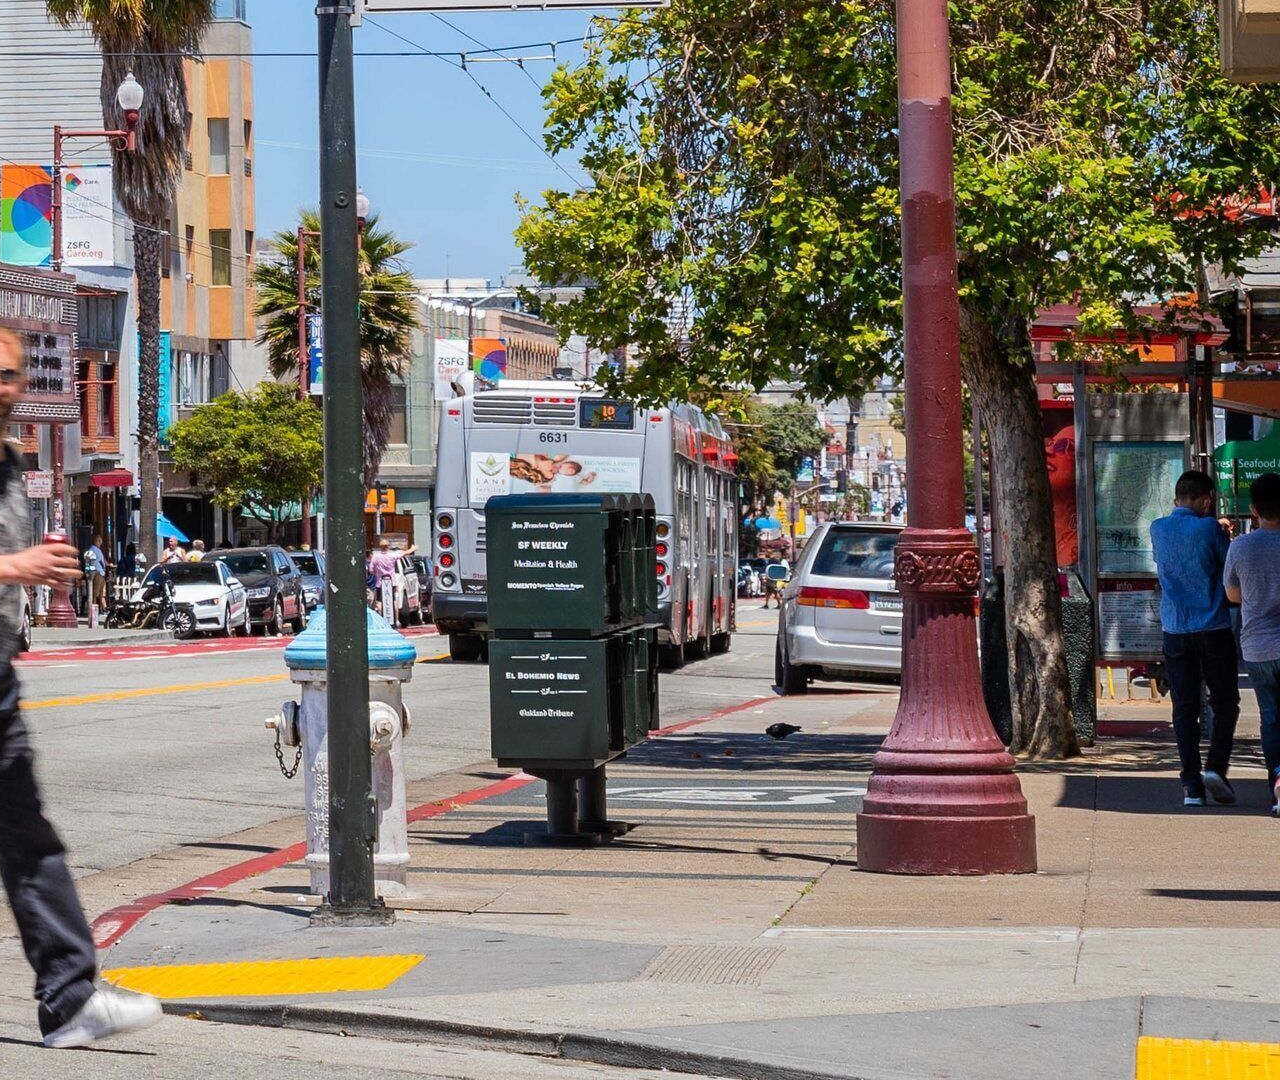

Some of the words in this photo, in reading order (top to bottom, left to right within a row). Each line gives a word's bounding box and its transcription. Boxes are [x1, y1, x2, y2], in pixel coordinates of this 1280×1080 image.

[66, 241, 90, 250] ZSFG
[66, 249, 104, 259] Care.org
[438, 357, 464, 366] ZSFG
[539, 432, 568, 443] 6631
[1238, 458, 1276, 468] Seafood
[517, 541, 530, 550] SF
[531, 541, 569, 550] WEEKLY
[513, 560, 547, 569] Meditation
[555, 560, 578, 569] Health
[1115, 582, 1133, 591] info
[519, 708, 547, 717] Oakland
[547, 708, 575, 717] Tribune
